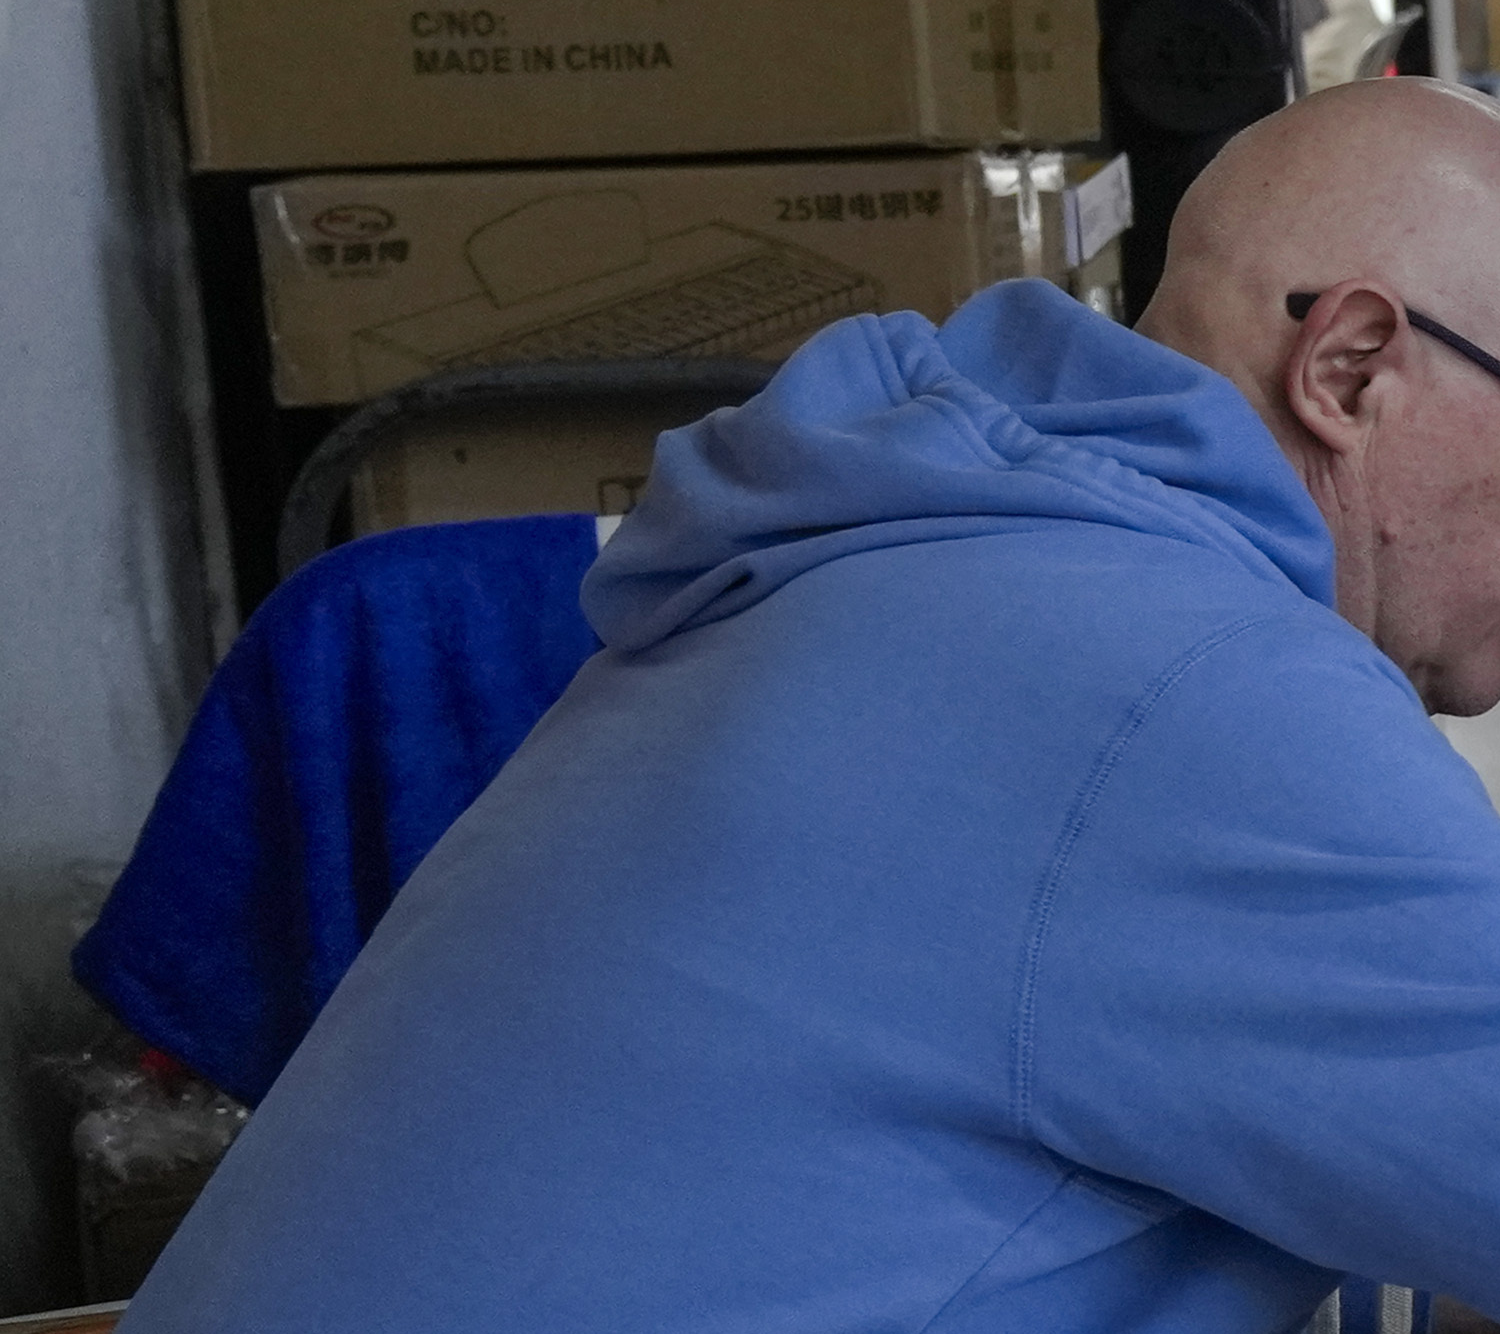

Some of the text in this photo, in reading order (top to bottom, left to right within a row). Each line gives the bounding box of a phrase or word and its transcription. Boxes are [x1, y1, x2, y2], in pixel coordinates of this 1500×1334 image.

[412, 41, 673, 75] MADE IN CHINA
